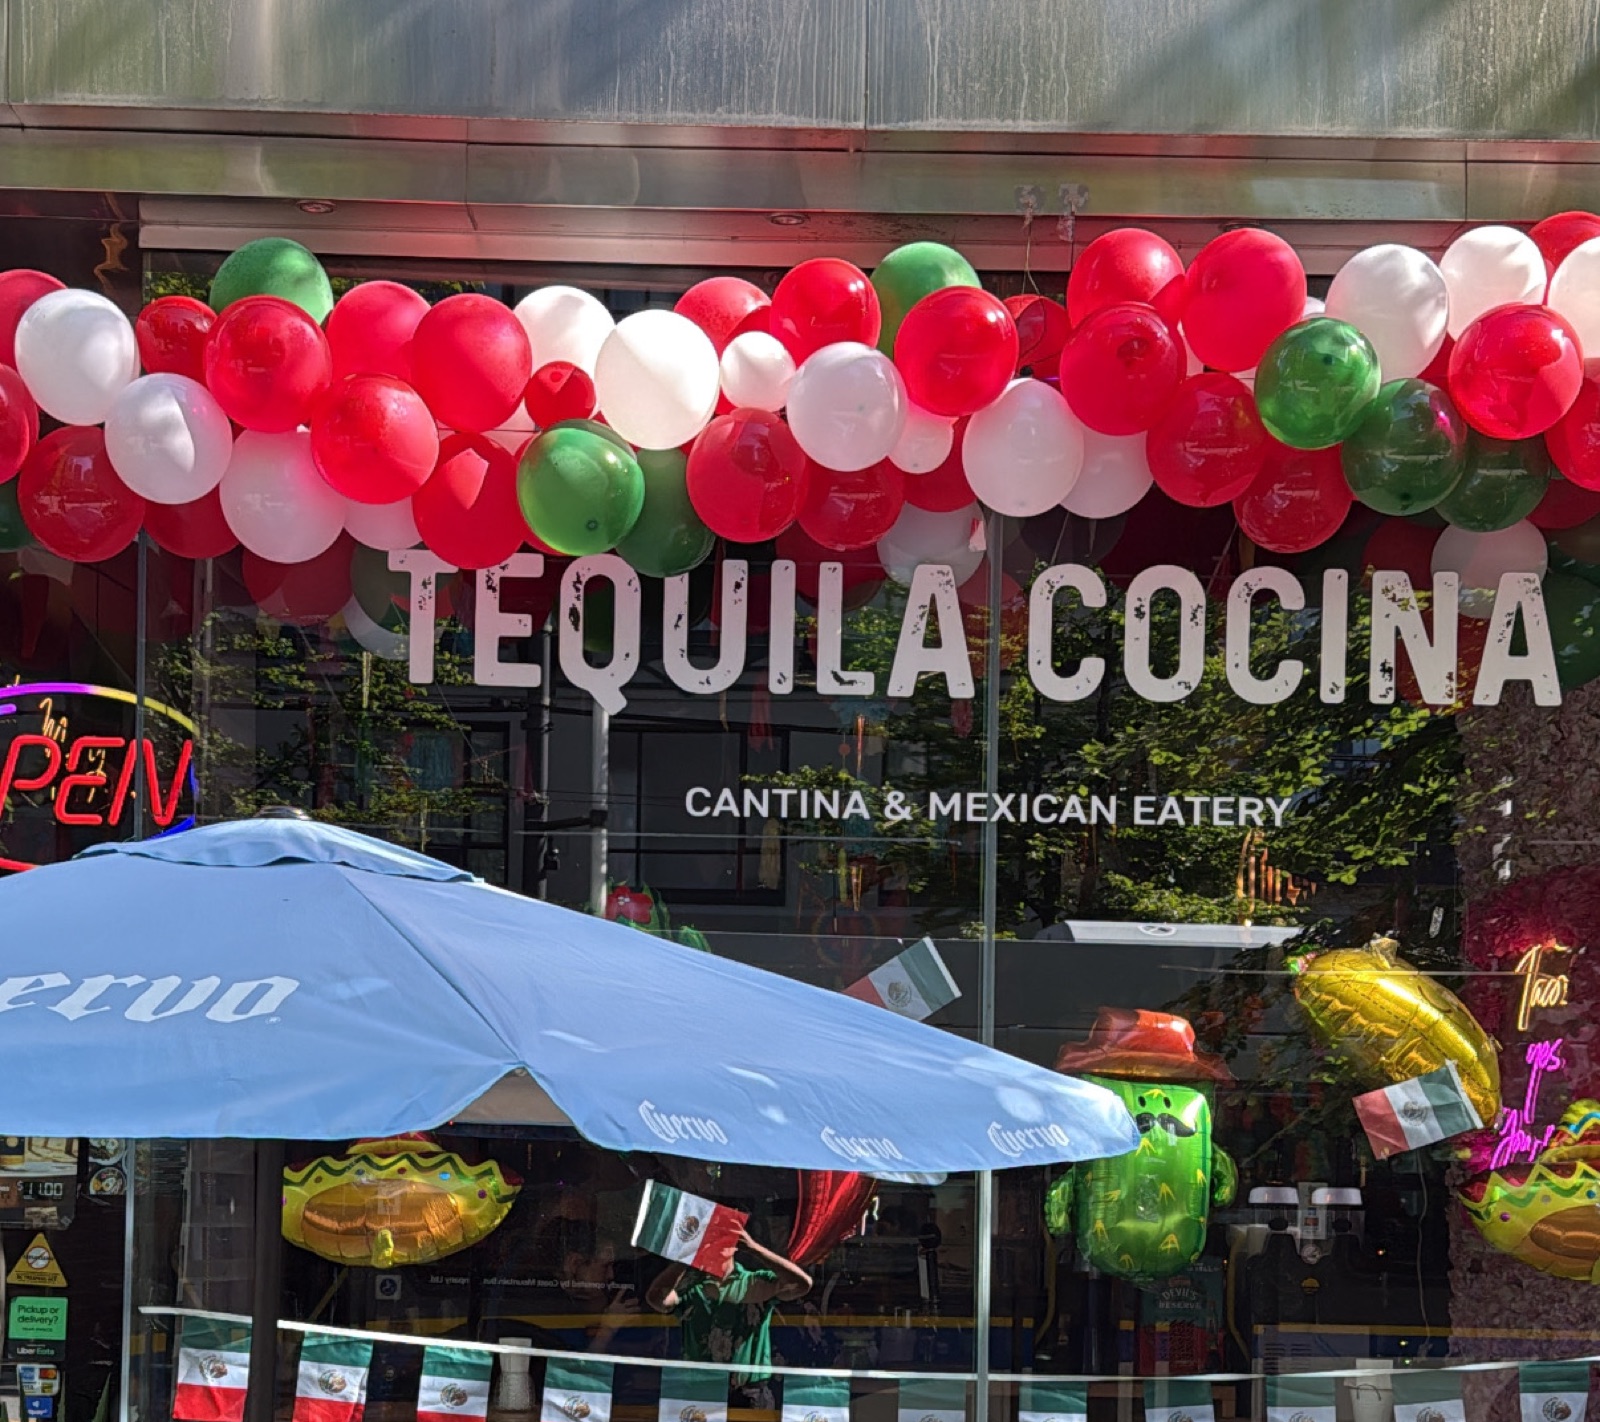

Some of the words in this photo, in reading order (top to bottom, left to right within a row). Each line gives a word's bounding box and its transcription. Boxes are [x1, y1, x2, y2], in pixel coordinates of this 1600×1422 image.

[388, 549, 975, 716] TEQUILA
[1028, 563, 1562, 706] COCINA
[685, 787, 870, 819] CANTINA
[883, 790, 914, 822] &
[929, 792, 1117, 825] MEXICAN
[1133, 796, 1292, 827] EATERY
[638, 1099, 729, 1145] Cuervo
[987, 1121, 1071, 1158] Cuervo
[820, 1125, 903, 1162] Cuervo
[17, 1304, 48, 1315] Pickup
[17, 1315, 59, 1326] delivery?
